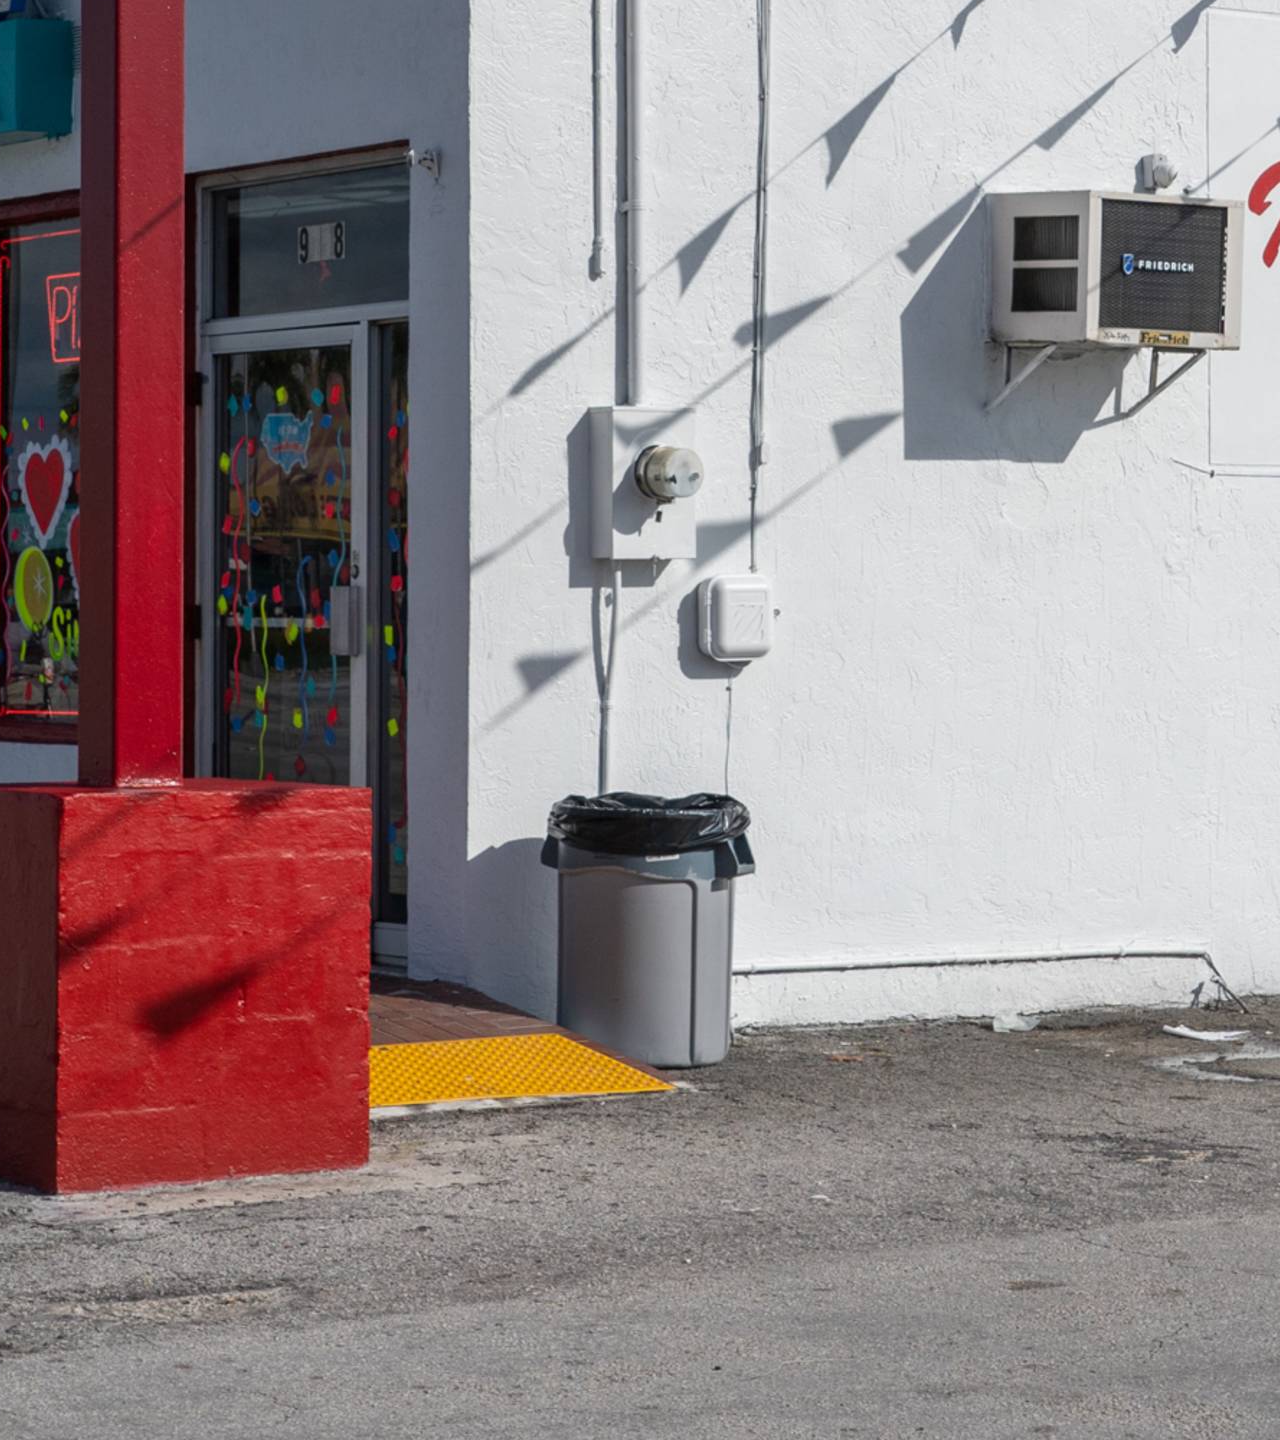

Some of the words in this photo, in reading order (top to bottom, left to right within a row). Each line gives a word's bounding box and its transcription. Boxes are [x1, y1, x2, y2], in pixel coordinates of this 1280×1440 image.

[1138, 260, 1194, 273] FRIEDRICH
[51, 285, 81, 352] PI
[1140, 331, 1189, 345] Friich
